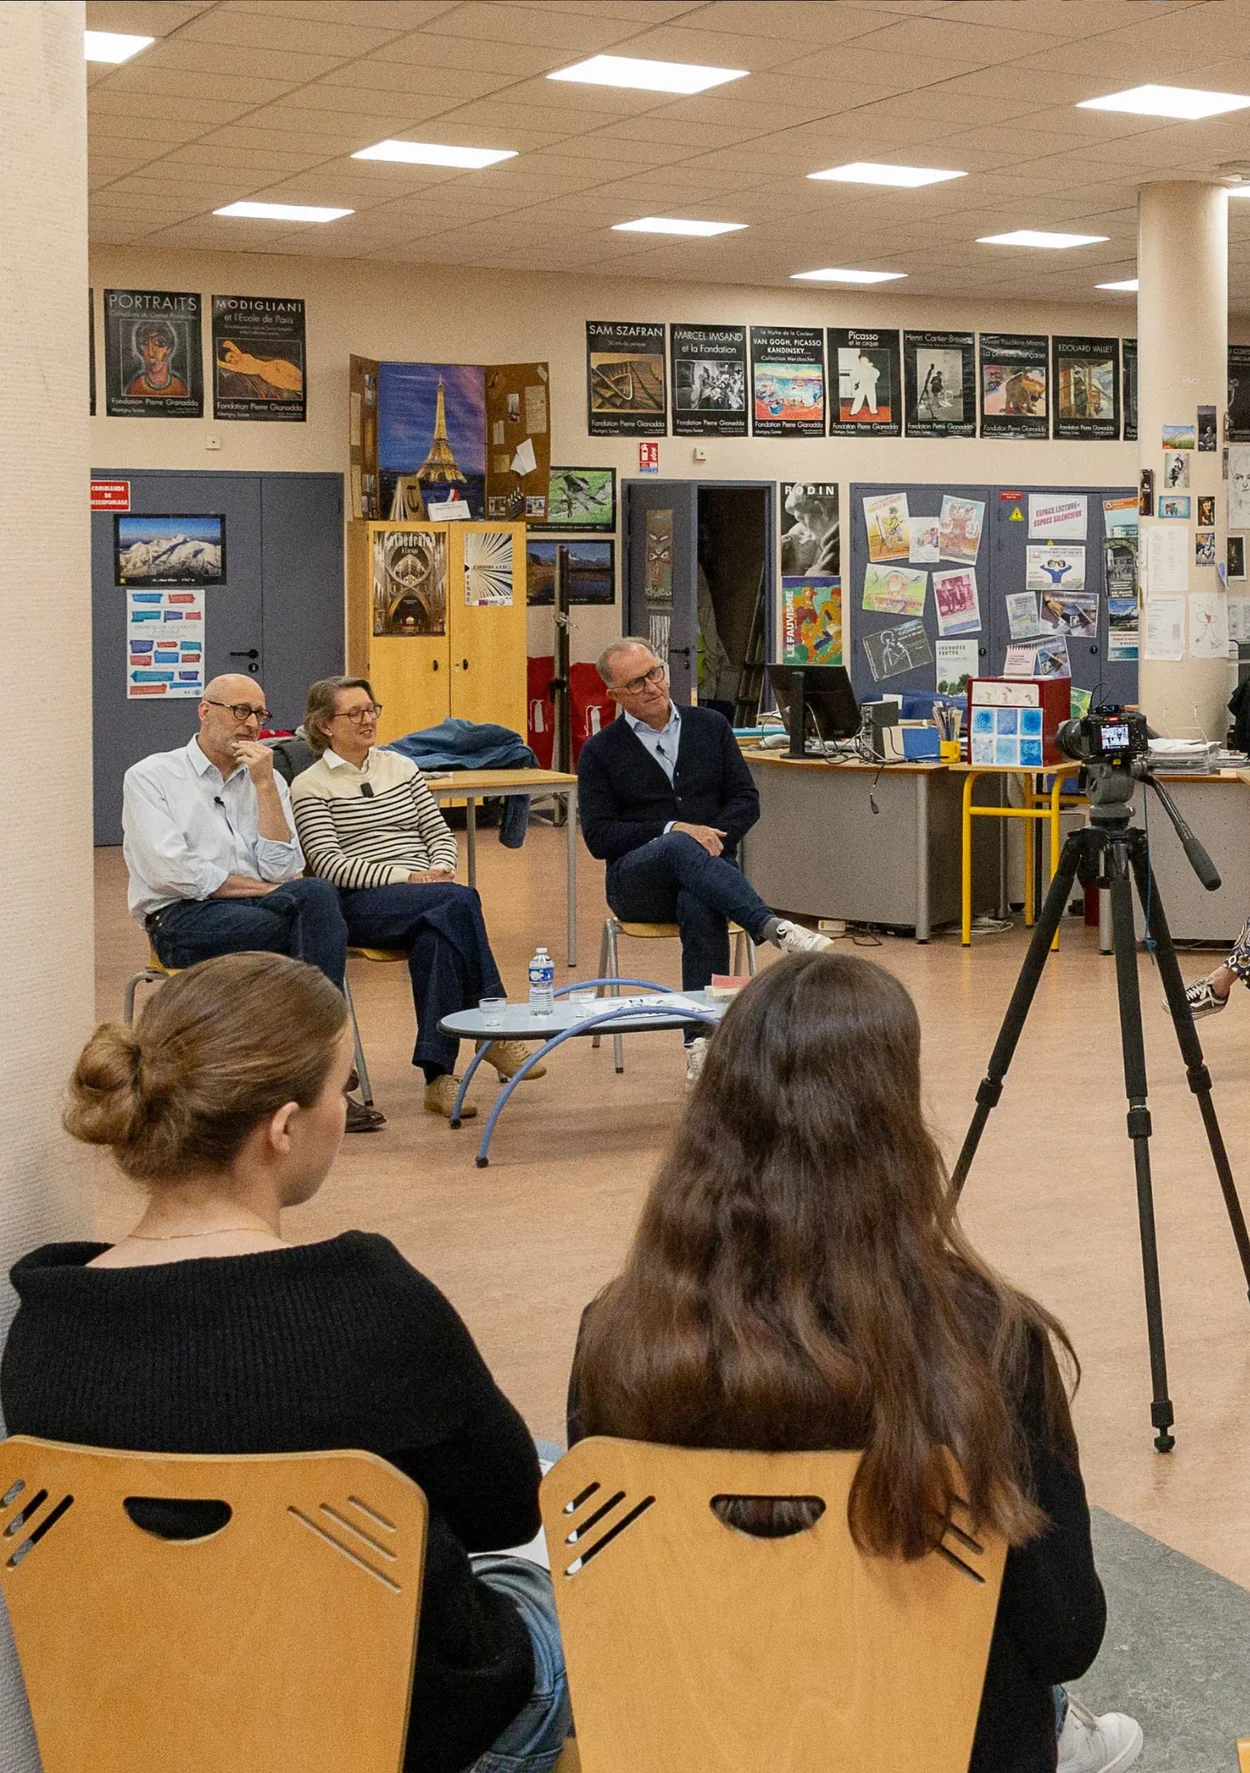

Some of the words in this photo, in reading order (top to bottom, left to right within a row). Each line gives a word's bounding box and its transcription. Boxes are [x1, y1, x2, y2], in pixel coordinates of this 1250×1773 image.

[109, 294, 197, 311] PORTRAITS
[216, 300, 302, 312] MODIGLIANI
[262, 314, 273, 323] de
[275, 315, 294, 324] Paris
[589, 325, 613, 335] SAM
[616, 326, 663, 337] SZAFRAN
[674, 331, 706, 341] MARCEL
[709, 332, 743, 342] IMSAND
[848, 330, 878, 340] Picasso
[681, 345, 689, 353] et
[691, 344, 698, 353] la
[700, 344, 737, 353] Fondation
[794, 339, 822, 347] PICASSO
[1058, 344, 1091, 352] EDOUARD
[1092, 345, 1112, 353] VALLET
[270, 403, 303, 411] Gianadda
[785, 485, 835, 495] RODIN
[1035, 506, 1055, 517] ESPACE
[1033, 516, 1052, 527] ESPACE
[786, 591, 795, 642] FAUVISME
[786, 644, 795, 658] LE
